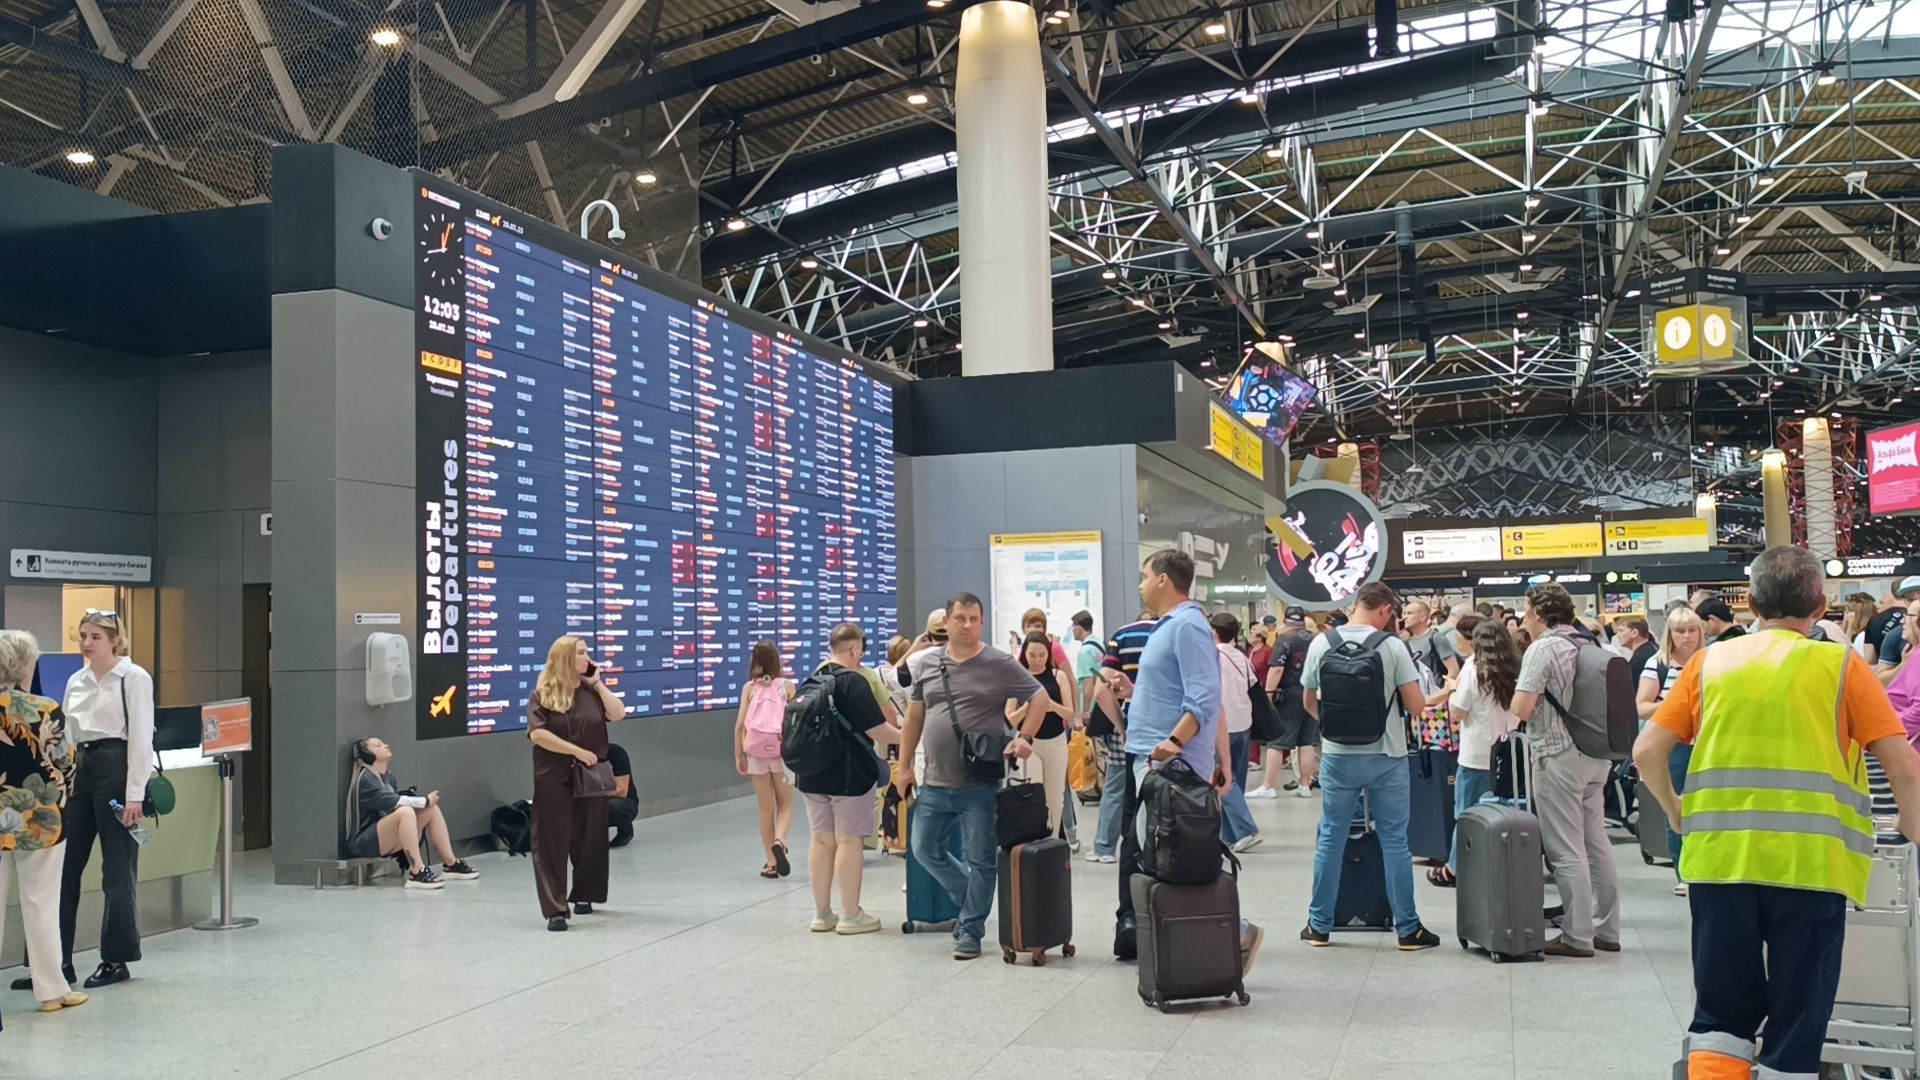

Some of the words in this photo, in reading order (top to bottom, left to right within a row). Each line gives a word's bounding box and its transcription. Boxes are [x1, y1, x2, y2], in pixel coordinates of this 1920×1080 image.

[424, 294, 460, 322] 12:03
[442, 439, 462, 654] Departures
[45, 557, 71, 565] Комната
[72, 560, 97, 568] ручного
[98, 561, 126, 569] досмотра
[127, 561, 147, 569] багажа
